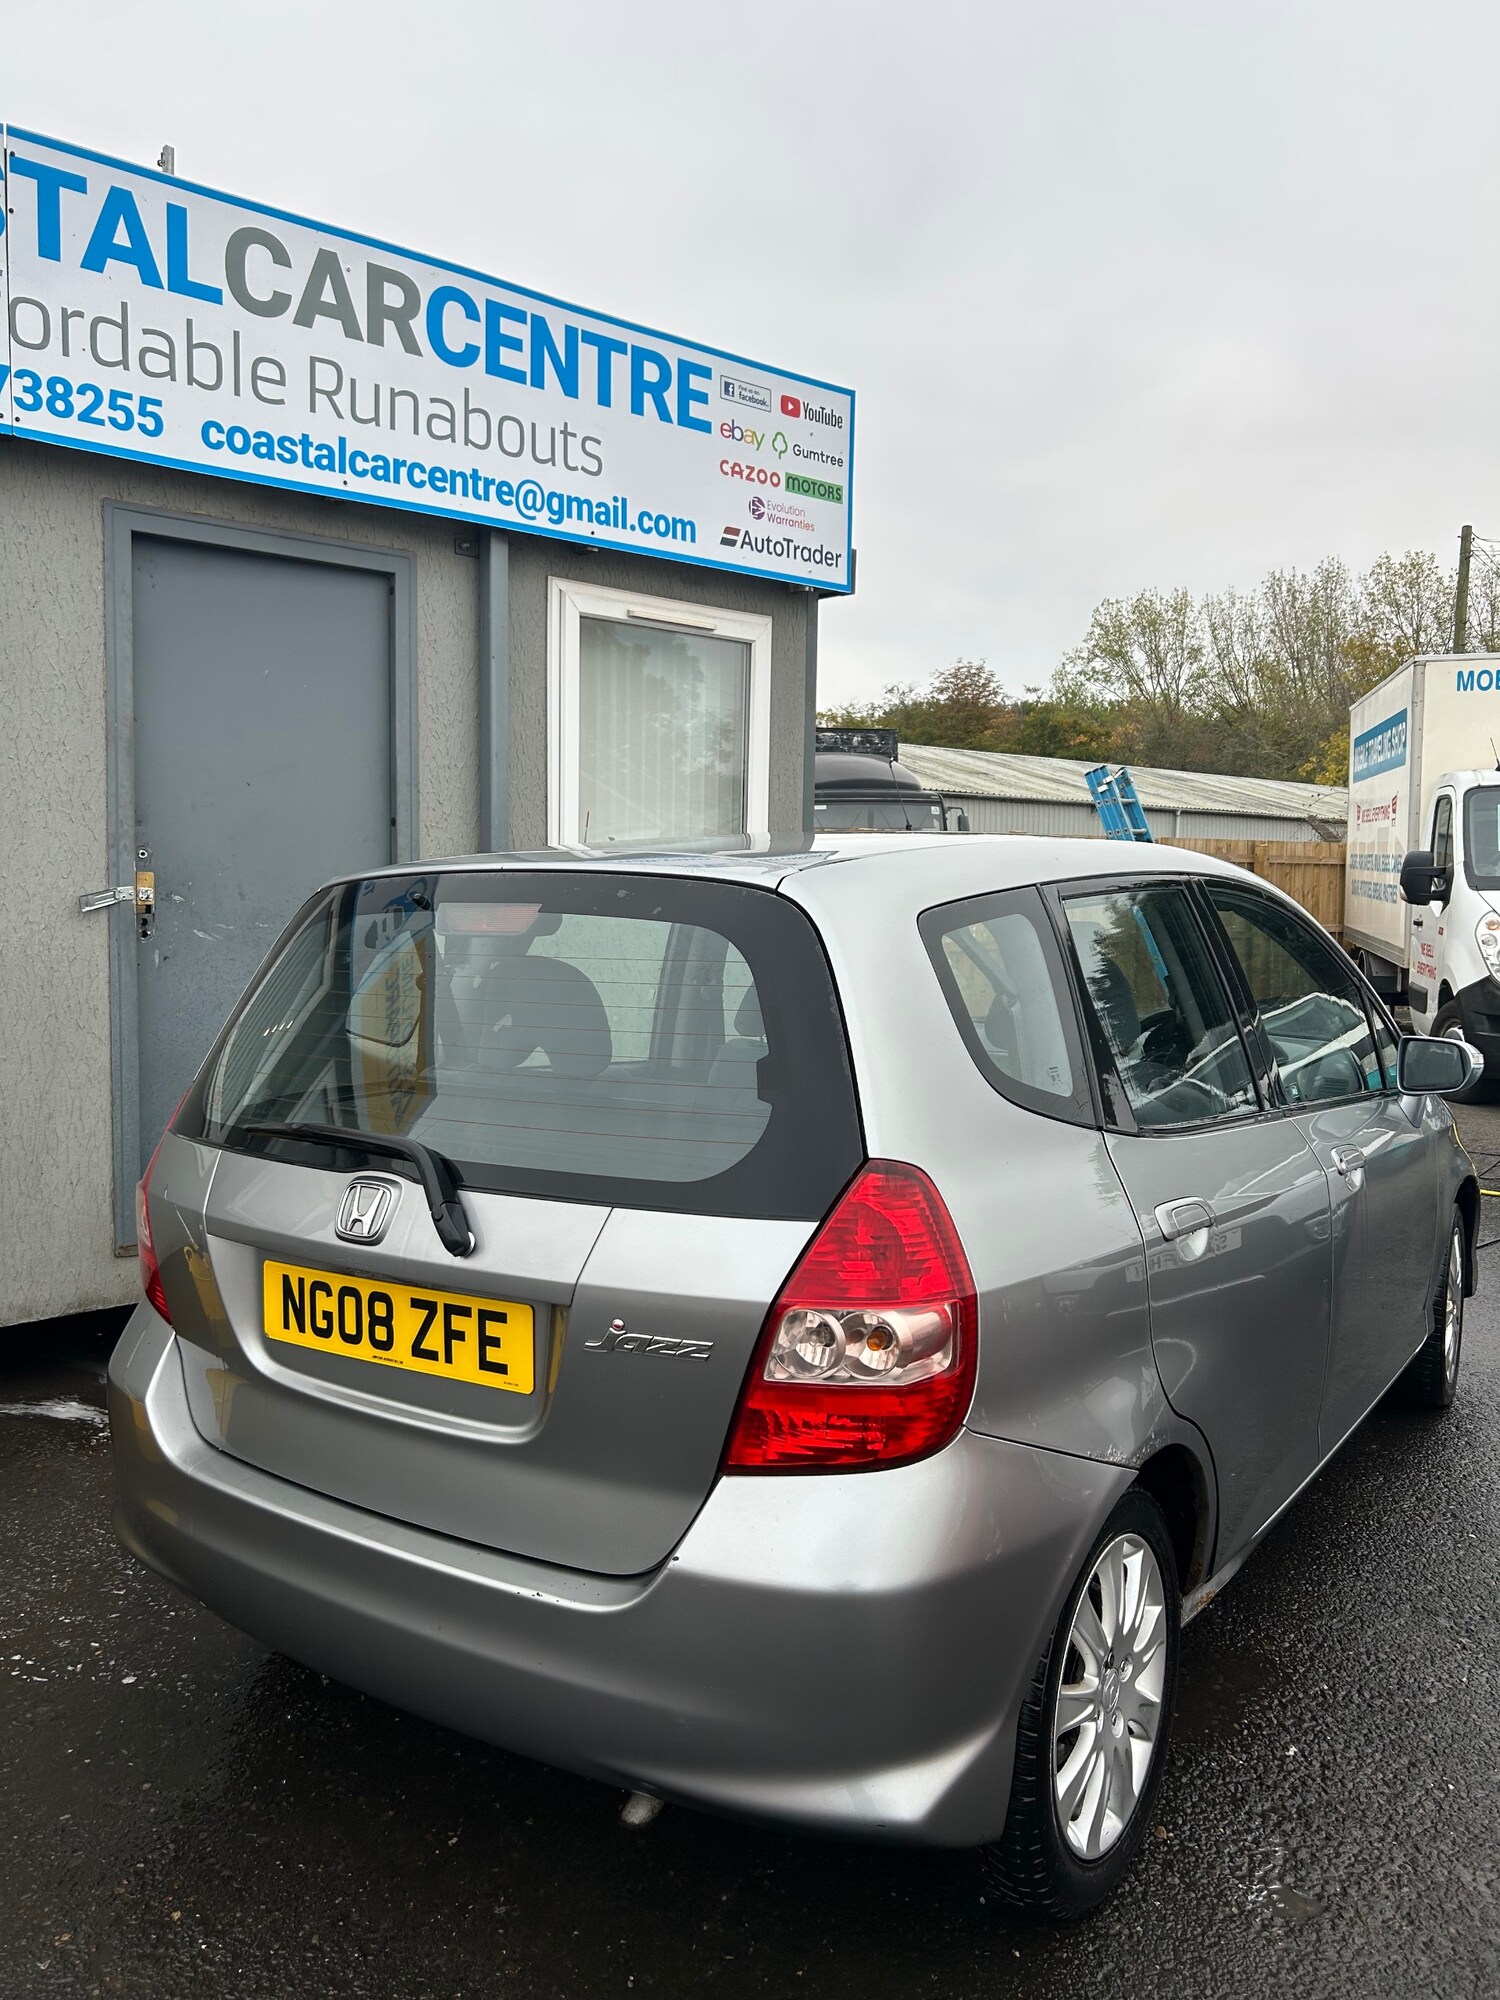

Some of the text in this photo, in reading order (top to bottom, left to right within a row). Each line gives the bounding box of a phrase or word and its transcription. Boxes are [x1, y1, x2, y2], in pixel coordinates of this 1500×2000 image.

[0, 155, 712, 434] TALCARCENTRE
[0, 269, 603, 477] ordable Runabouts
[802, 401, 843, 429] YouTube
[720, 419, 765, 451] ebay
[792, 444, 844, 467] Gumtree
[201, 419, 697, 543] coastalcarcentre@gmail.com
[720, 459, 781, 488] CAZOO
[786, 476, 842, 501] MOTORS
[767, 500, 806, 518] Evolution
[767, 513, 815, 532] Warranties
[740, 529, 842, 568] AutoTrader
[282, 1273, 509, 1376] NG08 ZFE
